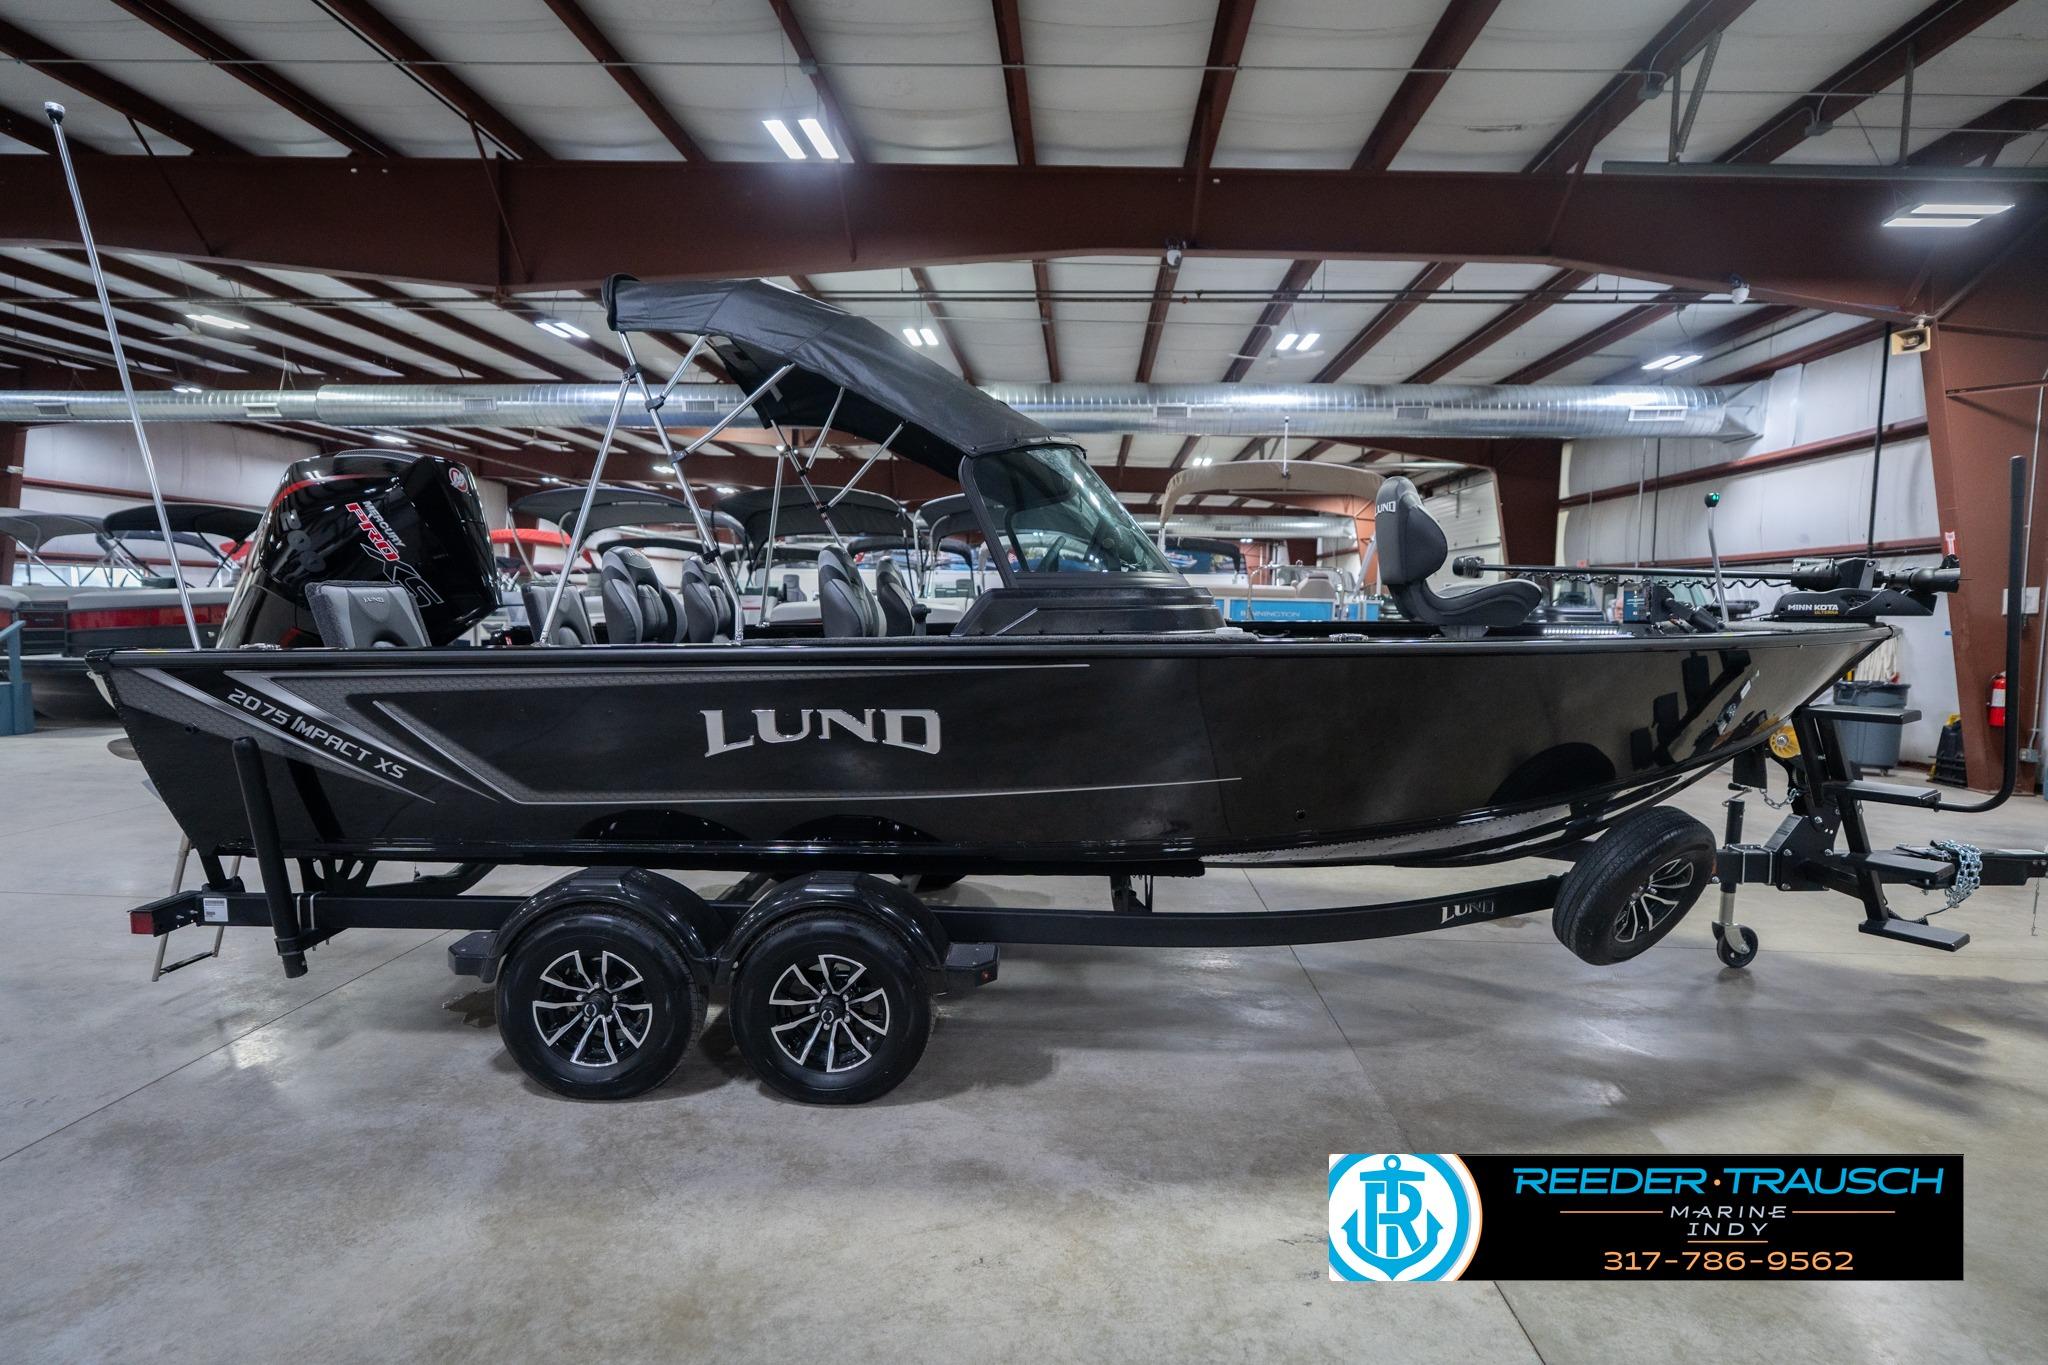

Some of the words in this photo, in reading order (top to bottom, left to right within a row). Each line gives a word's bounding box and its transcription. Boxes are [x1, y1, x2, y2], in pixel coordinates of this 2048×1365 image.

[345, 502, 399, 561] PRO
[362, 500, 406, 547] MERCURY
[227, 688, 291, 725] 2075
[374, 757, 408, 779] XS
[700, 709, 942, 758] LUND
[1441, 901, 1495, 924] LUND
